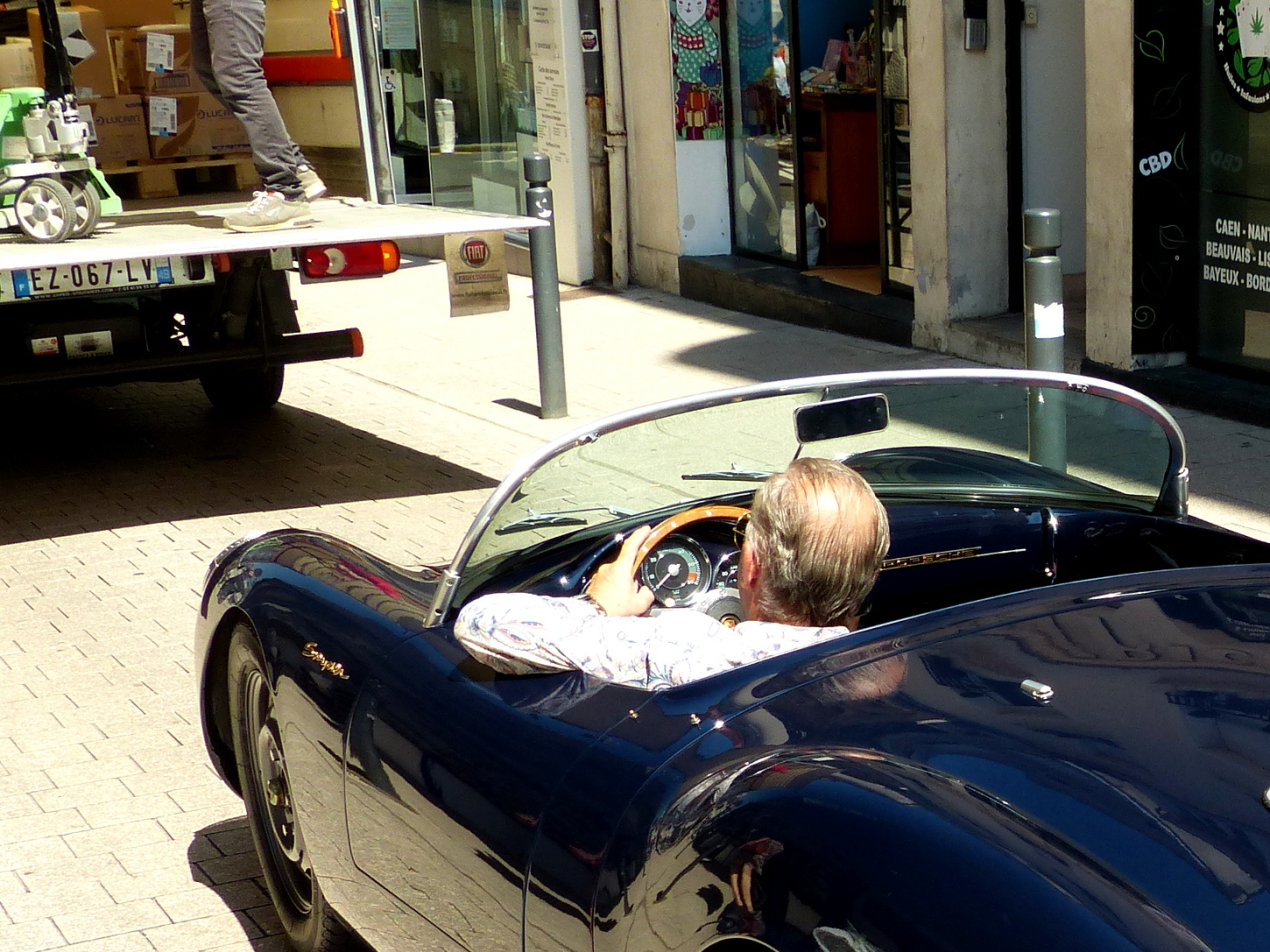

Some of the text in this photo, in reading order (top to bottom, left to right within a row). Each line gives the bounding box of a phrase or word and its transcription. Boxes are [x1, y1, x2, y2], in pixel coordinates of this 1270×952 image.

[1139, 150, 1172, 176] CBD
[1215, 218, 1241, 237] CAEN
[466, 245, 485, 260] FIAT
[1206, 241, 1251, 264] BEAUVAIS
[1203, 264, 1240, 286] BAYEUX
